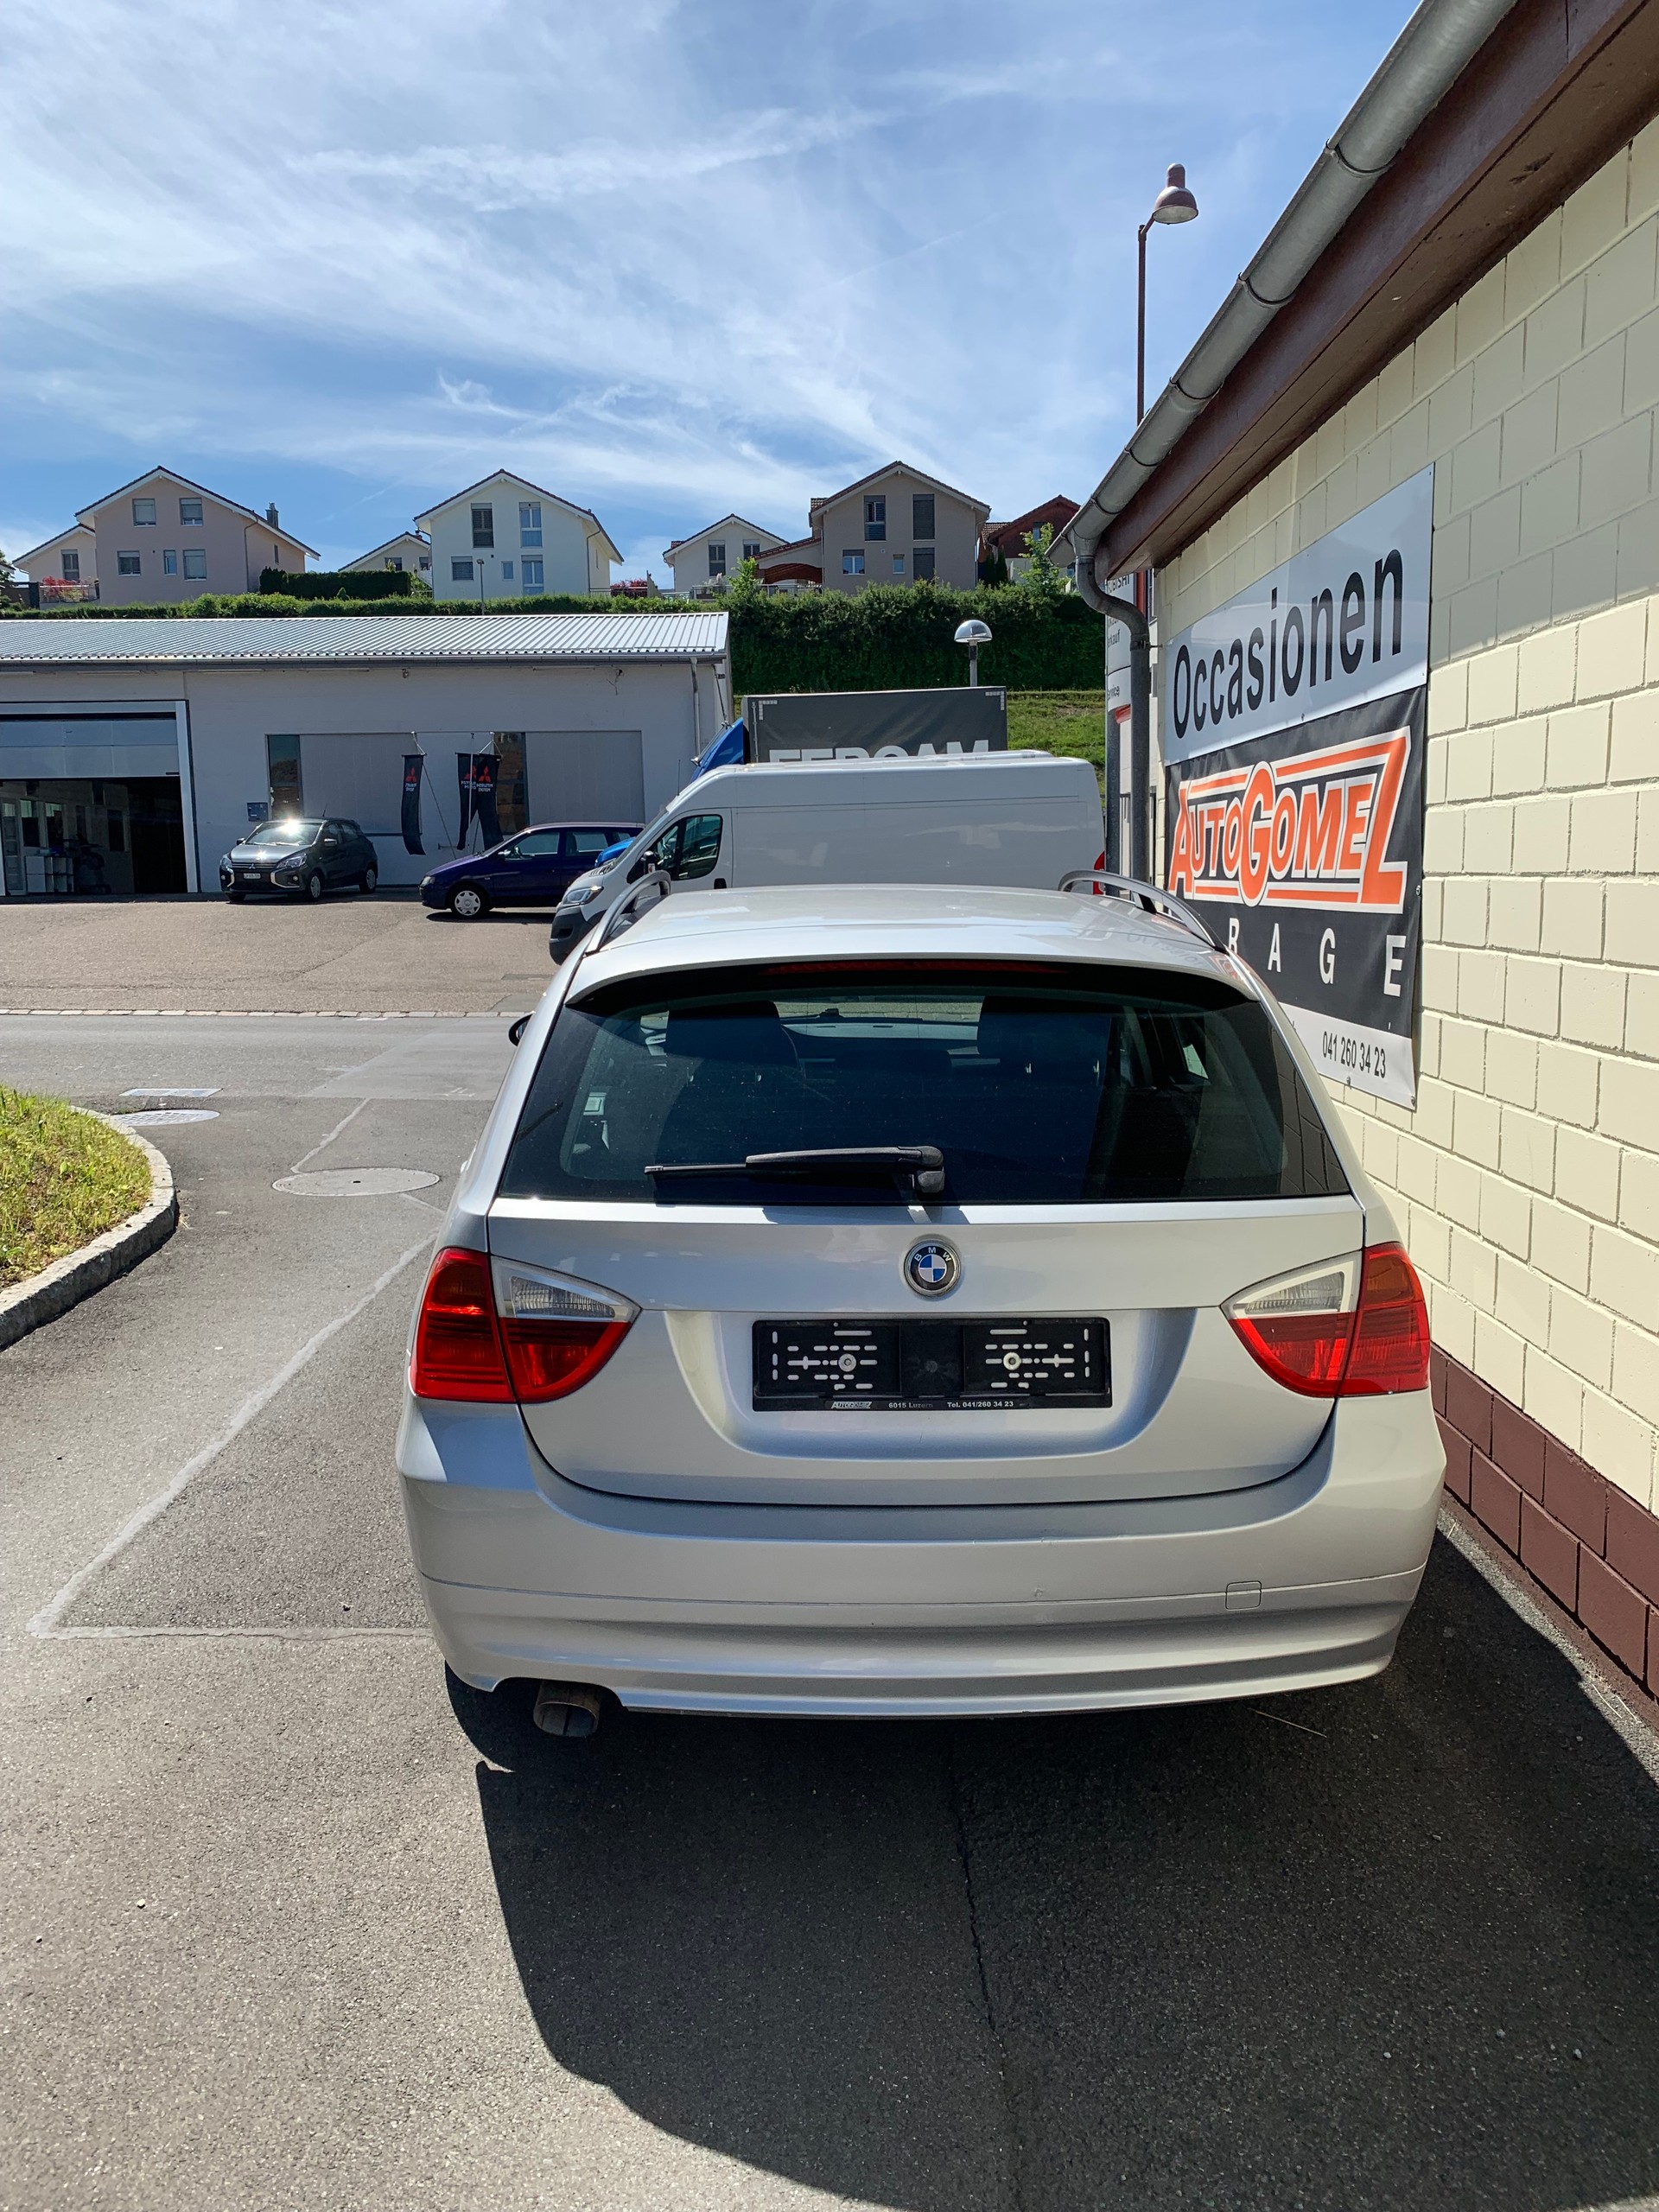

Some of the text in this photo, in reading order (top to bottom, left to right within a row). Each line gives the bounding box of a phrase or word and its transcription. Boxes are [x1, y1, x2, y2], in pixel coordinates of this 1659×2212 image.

[1173, 549, 1404, 740] Occasionen
[1229, 917, 1407, 997] RAGE
[1322, 1031, 1386, 1079] 041 260 34 23
[914, 1247, 951, 1262] BMW
